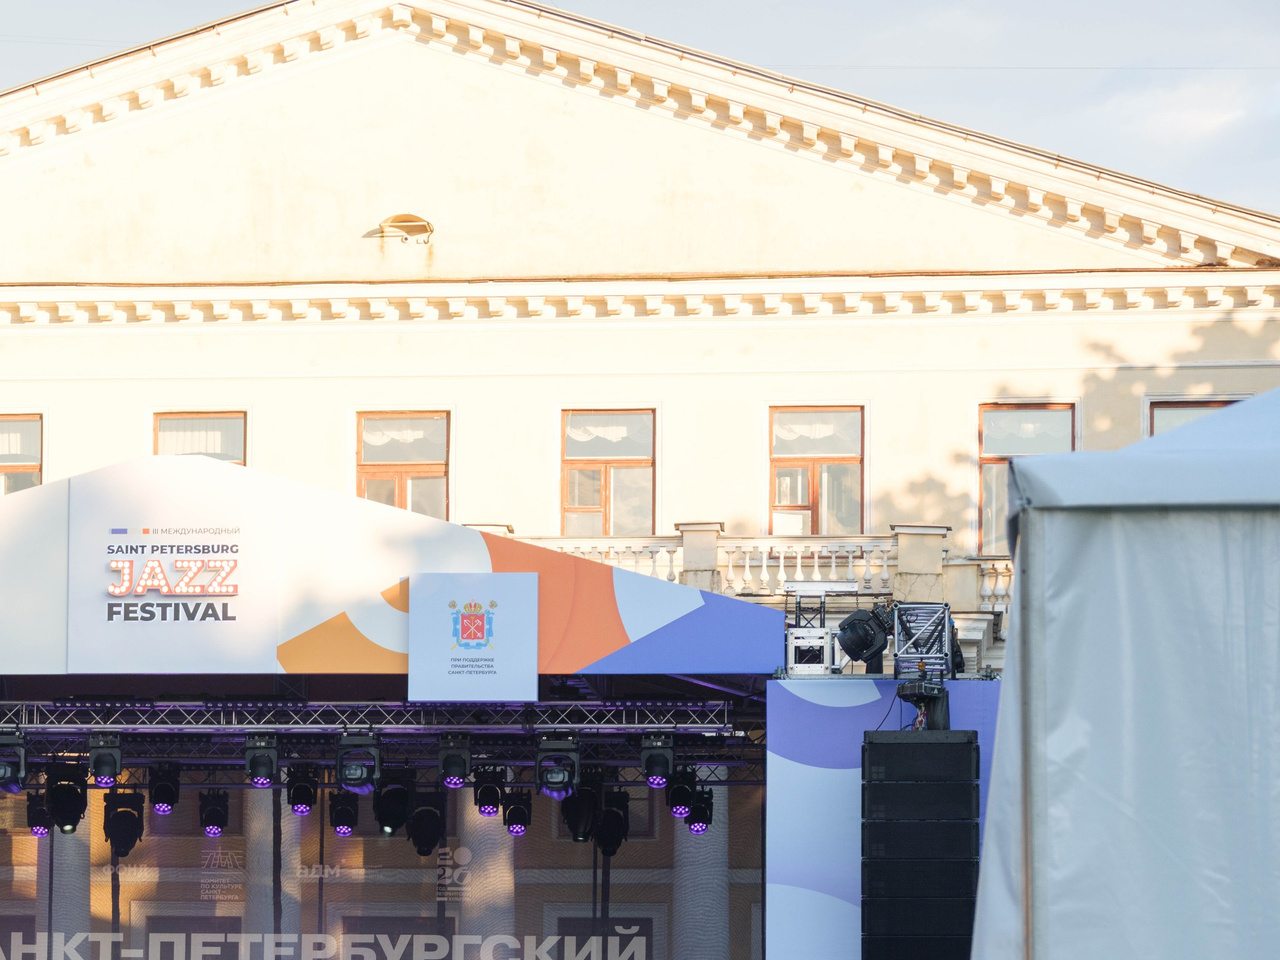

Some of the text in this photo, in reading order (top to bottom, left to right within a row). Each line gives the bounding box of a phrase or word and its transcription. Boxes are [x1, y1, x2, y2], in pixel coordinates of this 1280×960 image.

[161, 527, 240, 535] МЕЖДУНАРОДНЫЙ
[107, 544, 239, 555] SAINT PETERSBURG
[106, 559, 239, 597] JAZZ
[107, 602, 237, 622] FESTIVAL
